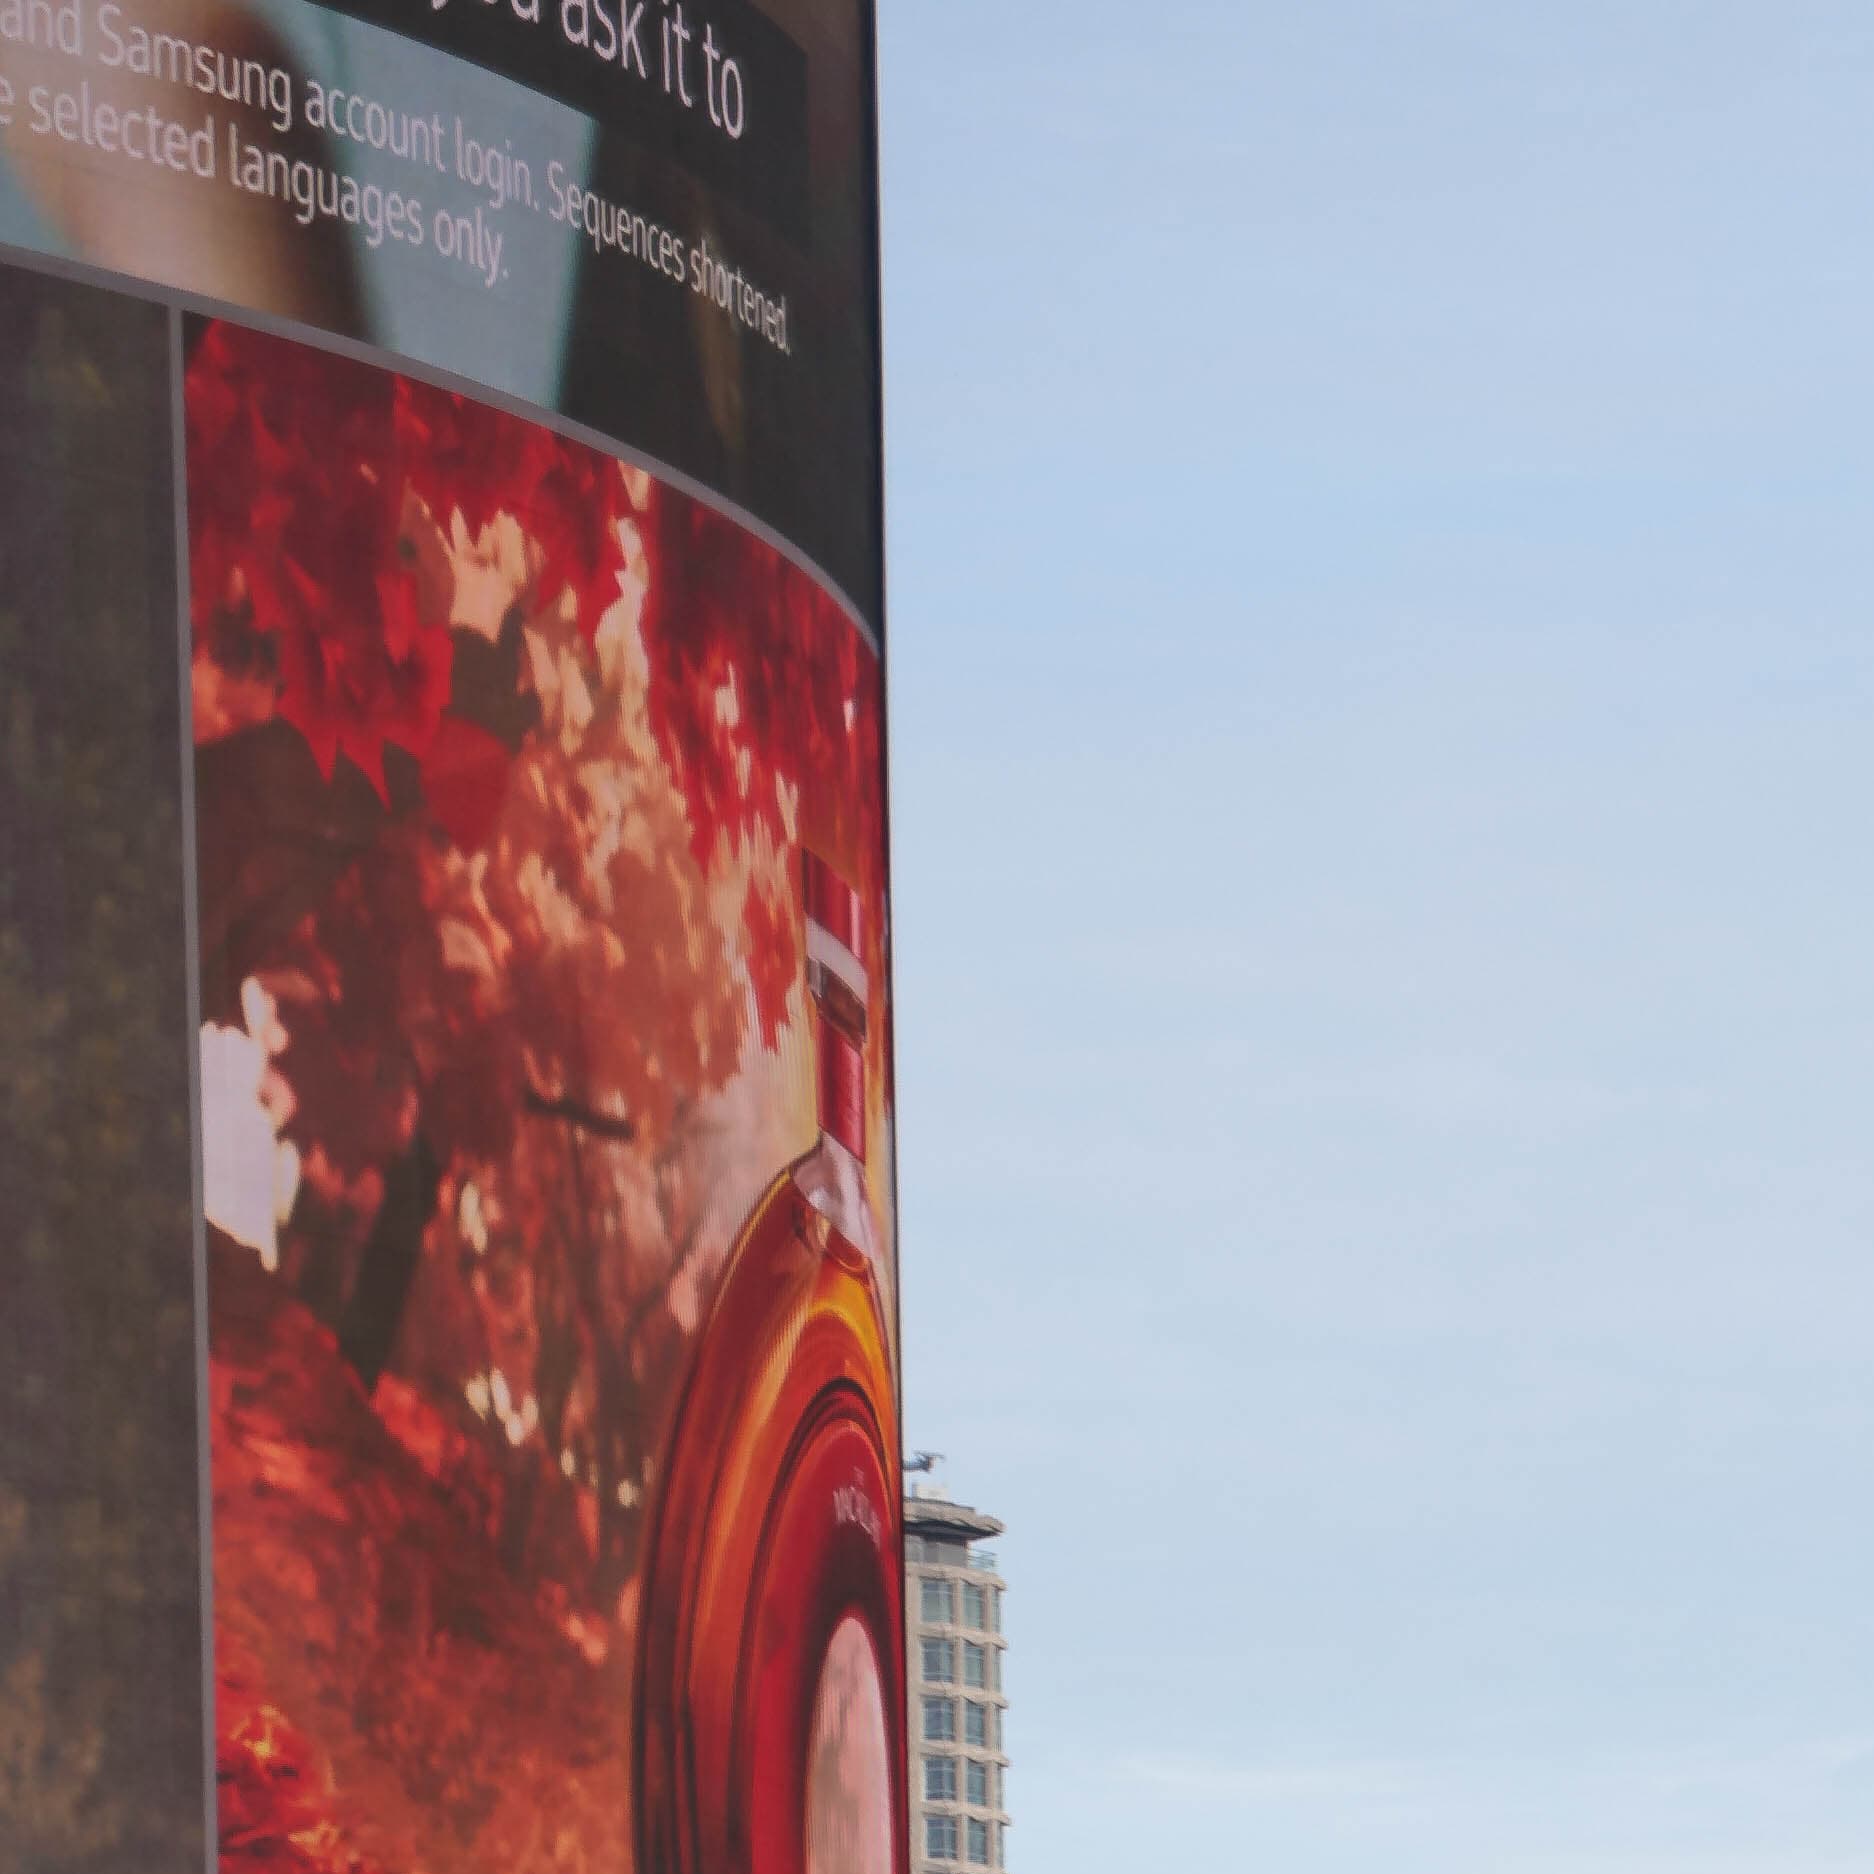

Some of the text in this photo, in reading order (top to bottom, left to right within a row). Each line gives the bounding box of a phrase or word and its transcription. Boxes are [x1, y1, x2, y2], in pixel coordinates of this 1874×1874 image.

[662, 0, 692, 107] it
[702, 23, 744, 139] to
[28, 81, 216, 178] selected
[229, 122, 425, 249] languages
[434, 206, 511, 289] only.
[99, 4, 293, 132] Samsung
[304, 79, 447, 172] account
[455, 114, 540, 211] login.
[546, 159, 685, 283] Sequences
[690, 238, 791, 356] shortened.
